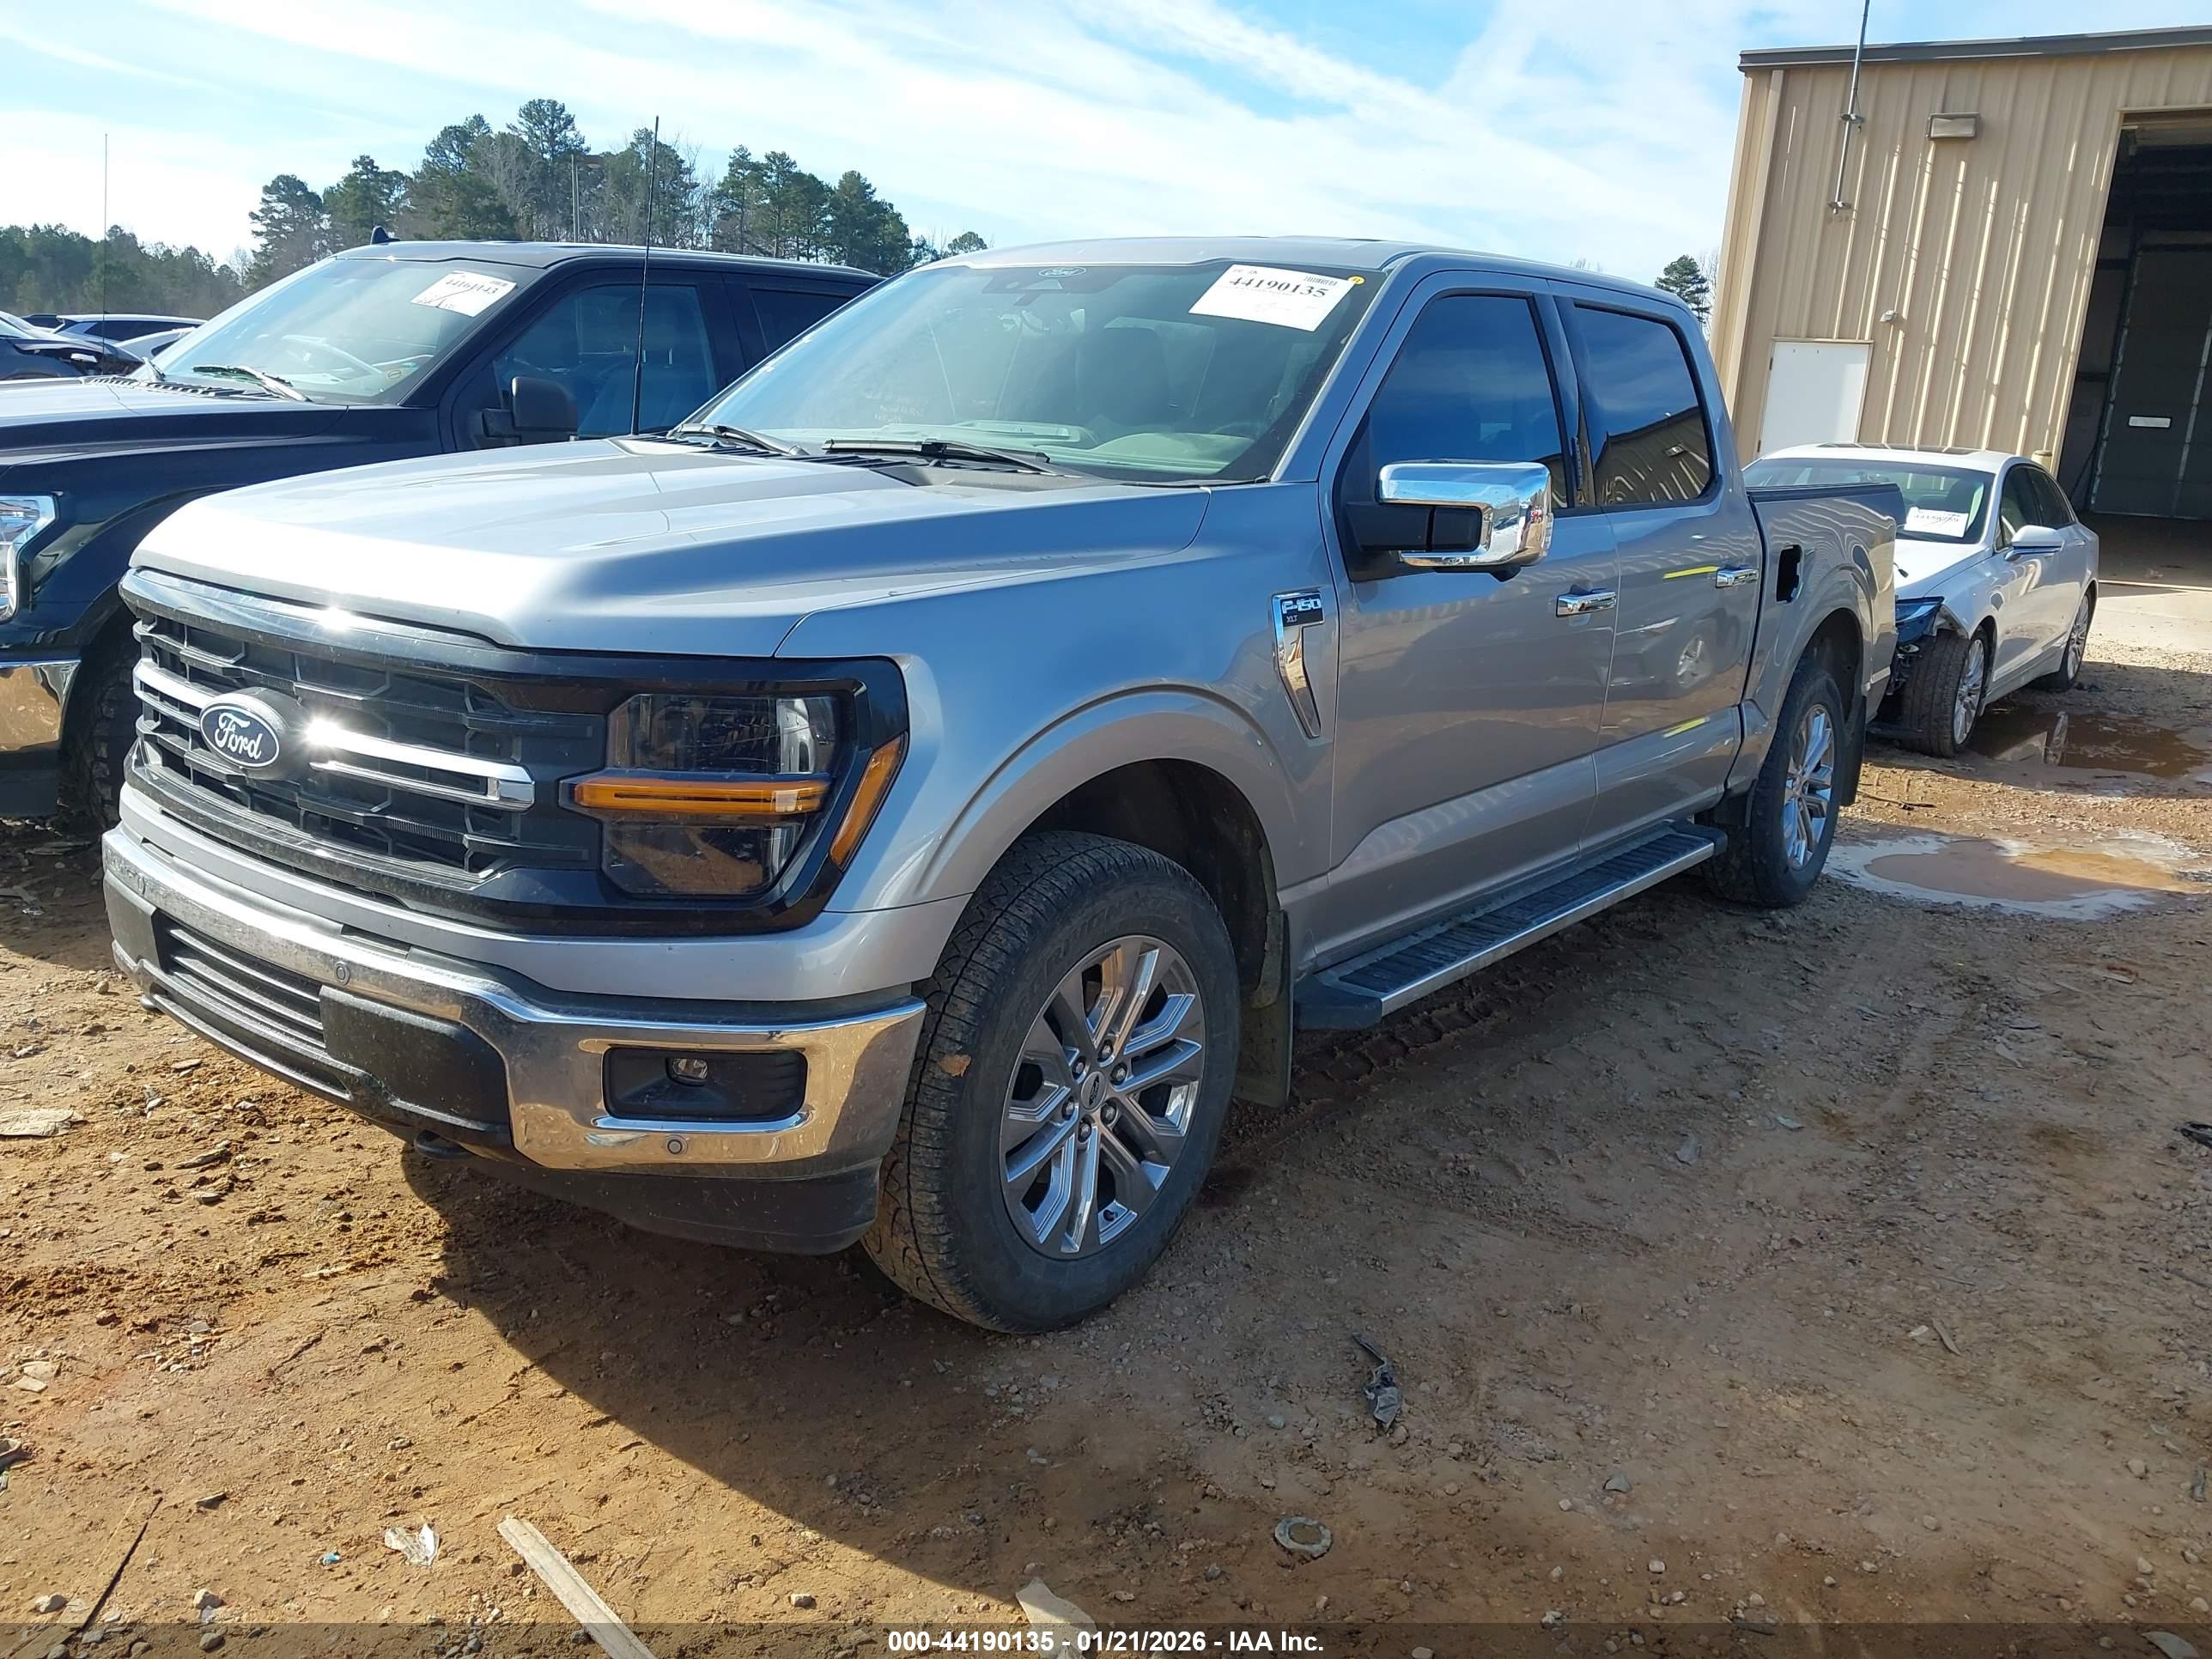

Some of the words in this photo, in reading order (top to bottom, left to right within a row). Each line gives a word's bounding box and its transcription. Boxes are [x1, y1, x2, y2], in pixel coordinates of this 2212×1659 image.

[1229, 276, 1329, 298] 44190135
[1282, 598, 1322, 614] F-150
[1286, 614, 1298, 623] XLT
[215, 712, 263, 760] Ford
